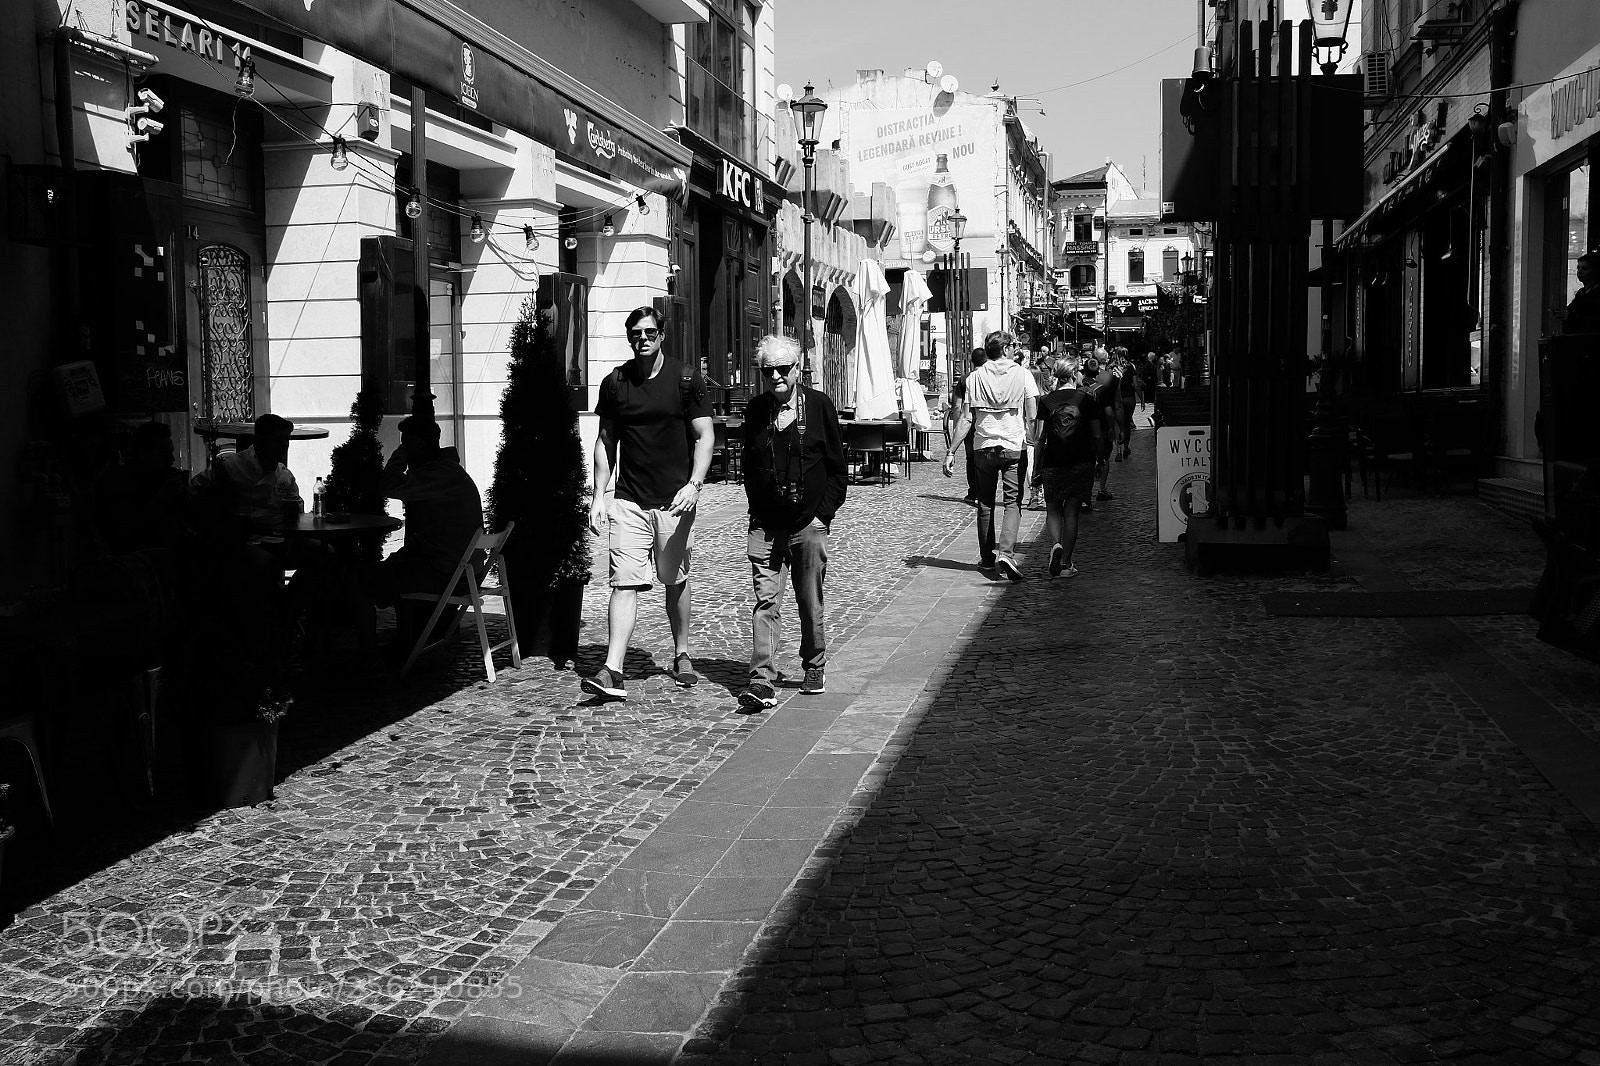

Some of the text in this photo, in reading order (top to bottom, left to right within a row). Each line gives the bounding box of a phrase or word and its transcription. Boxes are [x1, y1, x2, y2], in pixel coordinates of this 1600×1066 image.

[587, 121, 616, 159] Carlsberg
[919, 126, 955, 147] REVINE
[952, 142, 975, 159] NOU
[722, 159, 751, 208] KFC
[187, 225, 199, 240] 14
